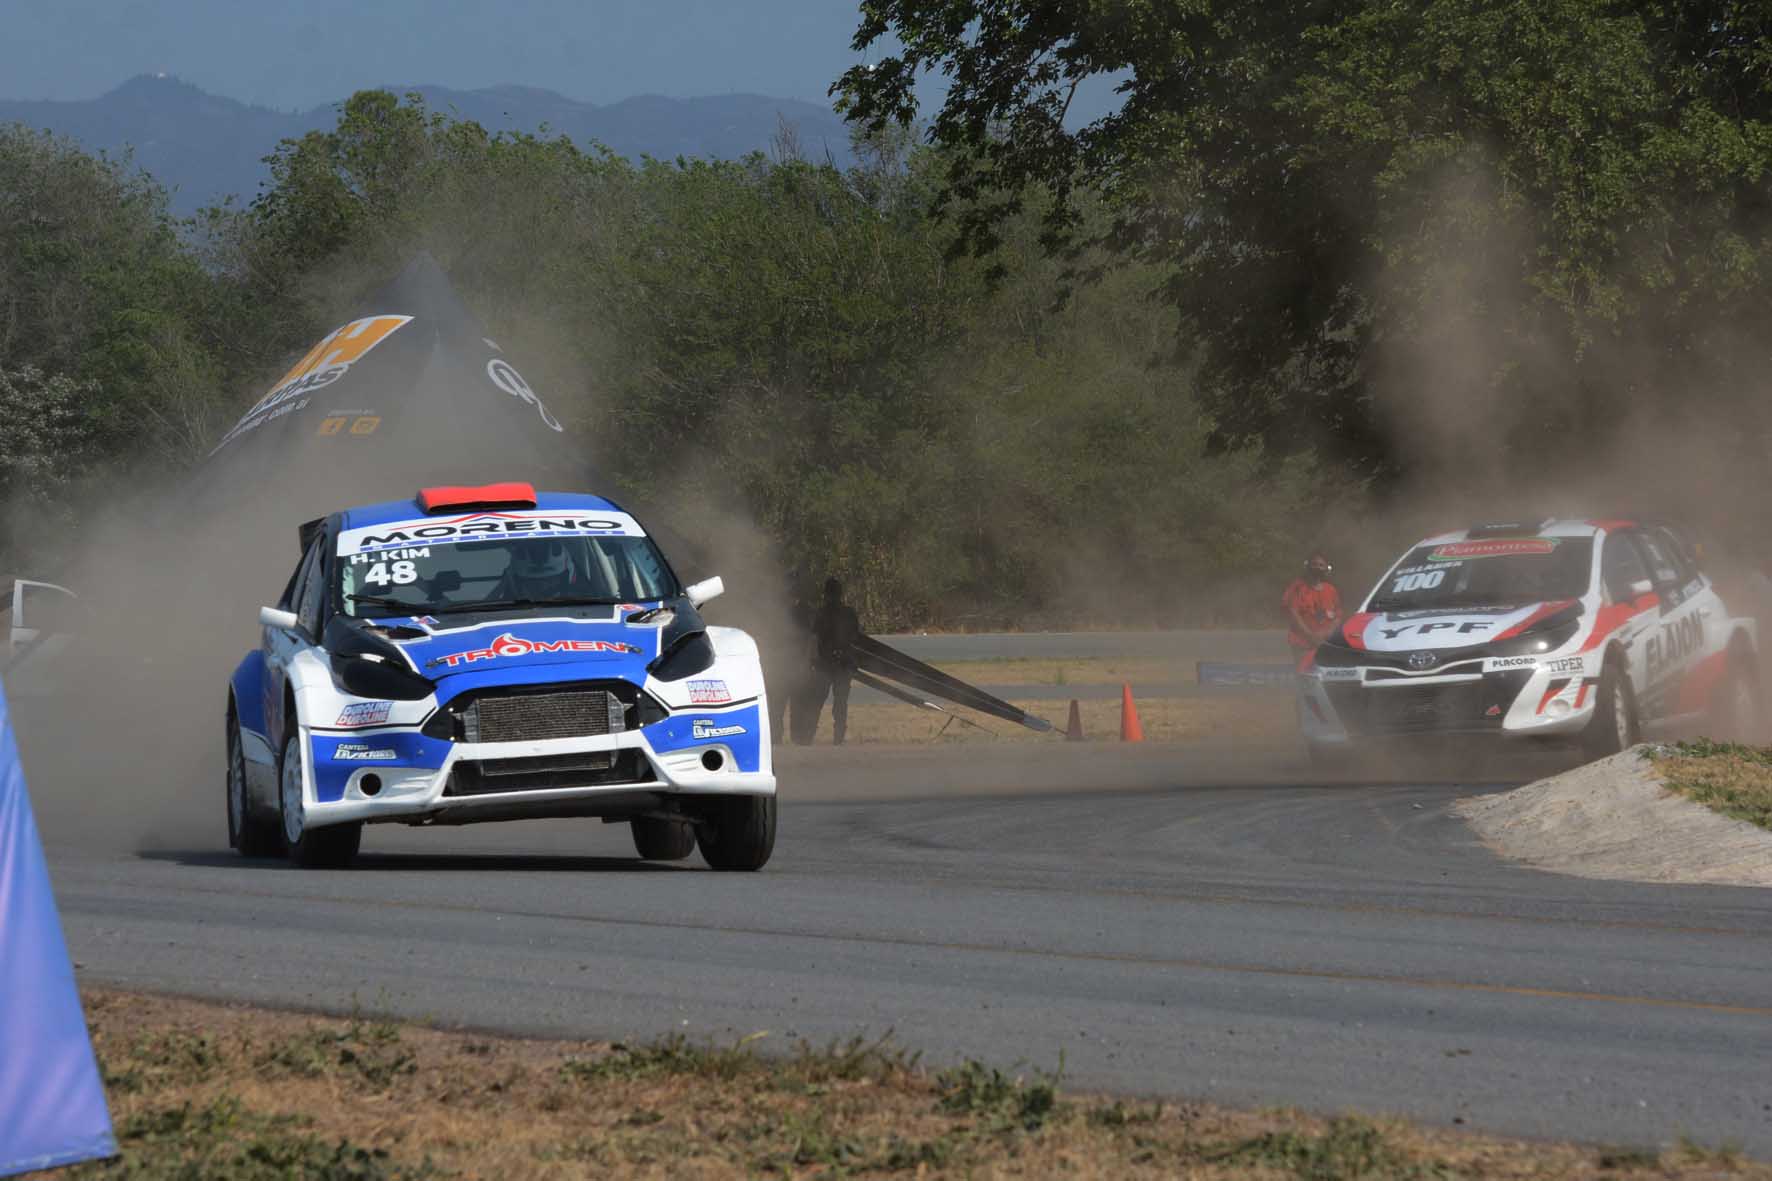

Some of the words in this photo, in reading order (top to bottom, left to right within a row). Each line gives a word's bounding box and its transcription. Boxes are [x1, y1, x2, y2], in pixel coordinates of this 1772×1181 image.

[360, 519, 623, 546] MORENO
[350, 553, 375, 566] H.
[380, 547, 430, 561] KIM
[364, 561, 418, 587] 48
[1391, 570, 1446, 593] 100
[1379, 621, 1494, 640] YPF
[444, 632, 629, 666] TROMEN
[1546, 656, 1584, 672] TIPER
